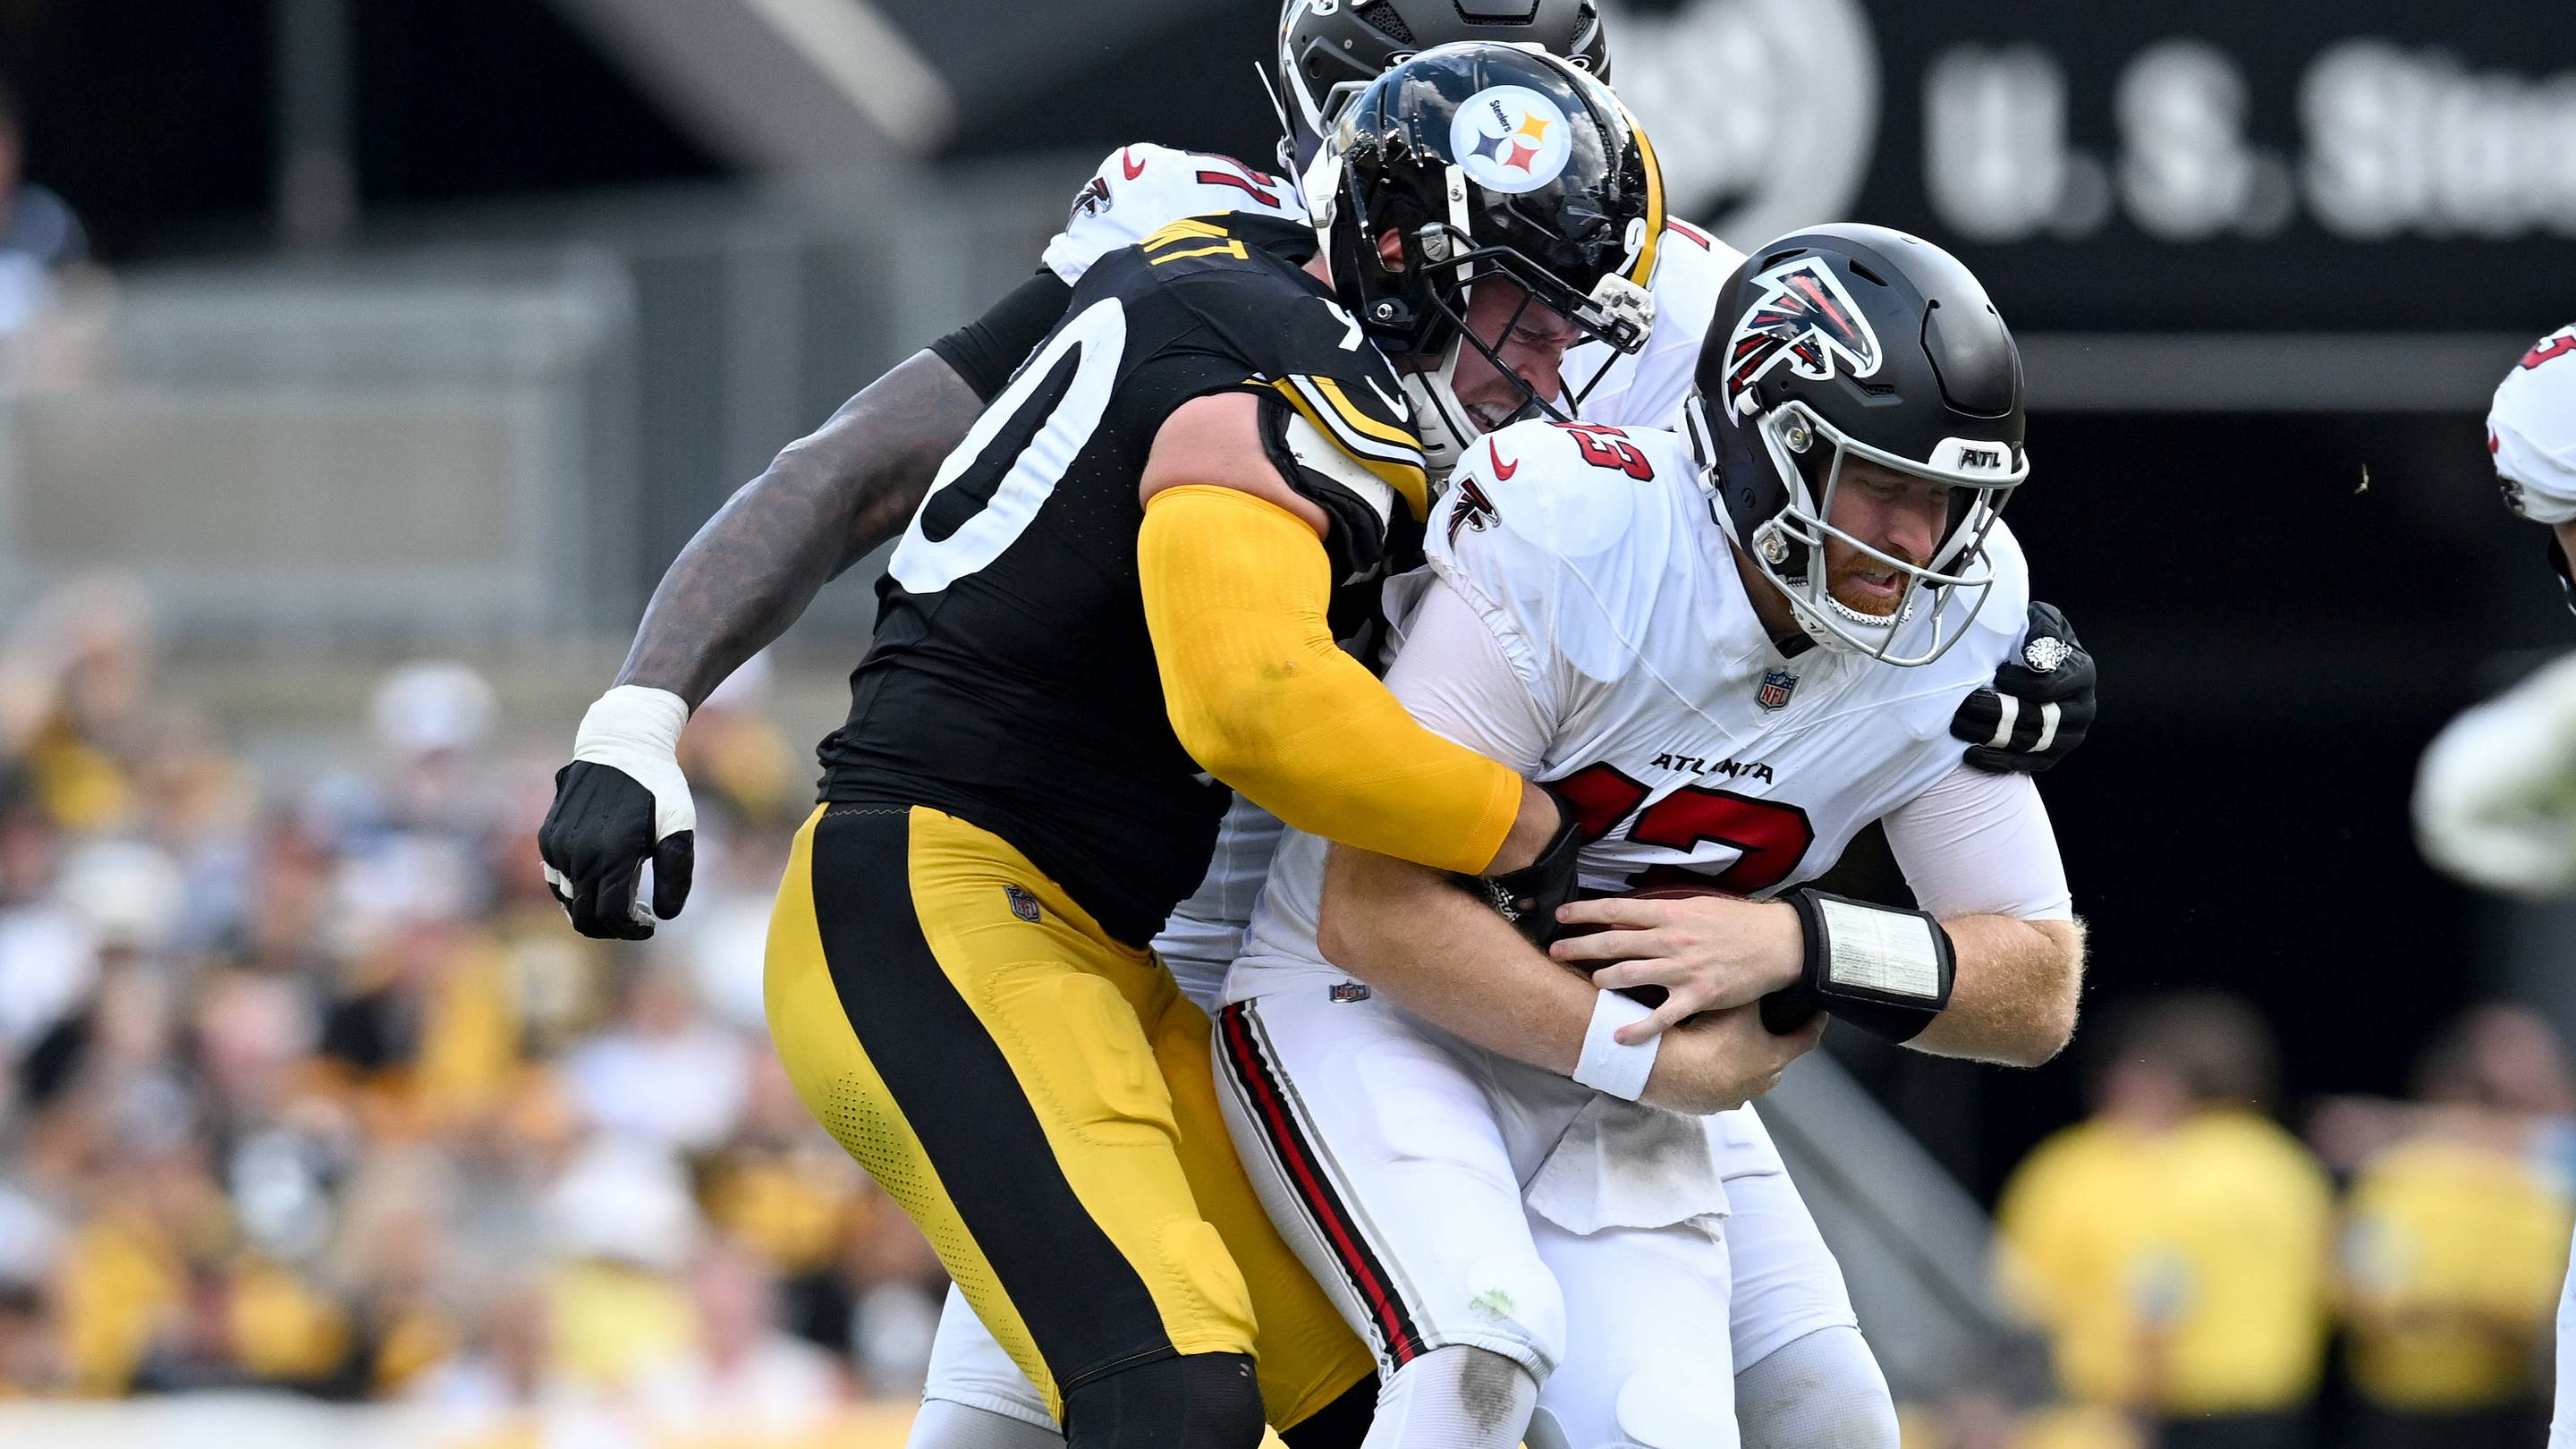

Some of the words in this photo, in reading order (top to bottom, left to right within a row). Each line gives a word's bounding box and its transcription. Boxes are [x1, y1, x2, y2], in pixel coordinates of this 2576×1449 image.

[1489, 99, 1513, 132] Steelers
[1958, 447, 2002, 470] ATL
[1760, 684, 1790, 706] NFL
[1336, 988, 1365, 998] NFL
